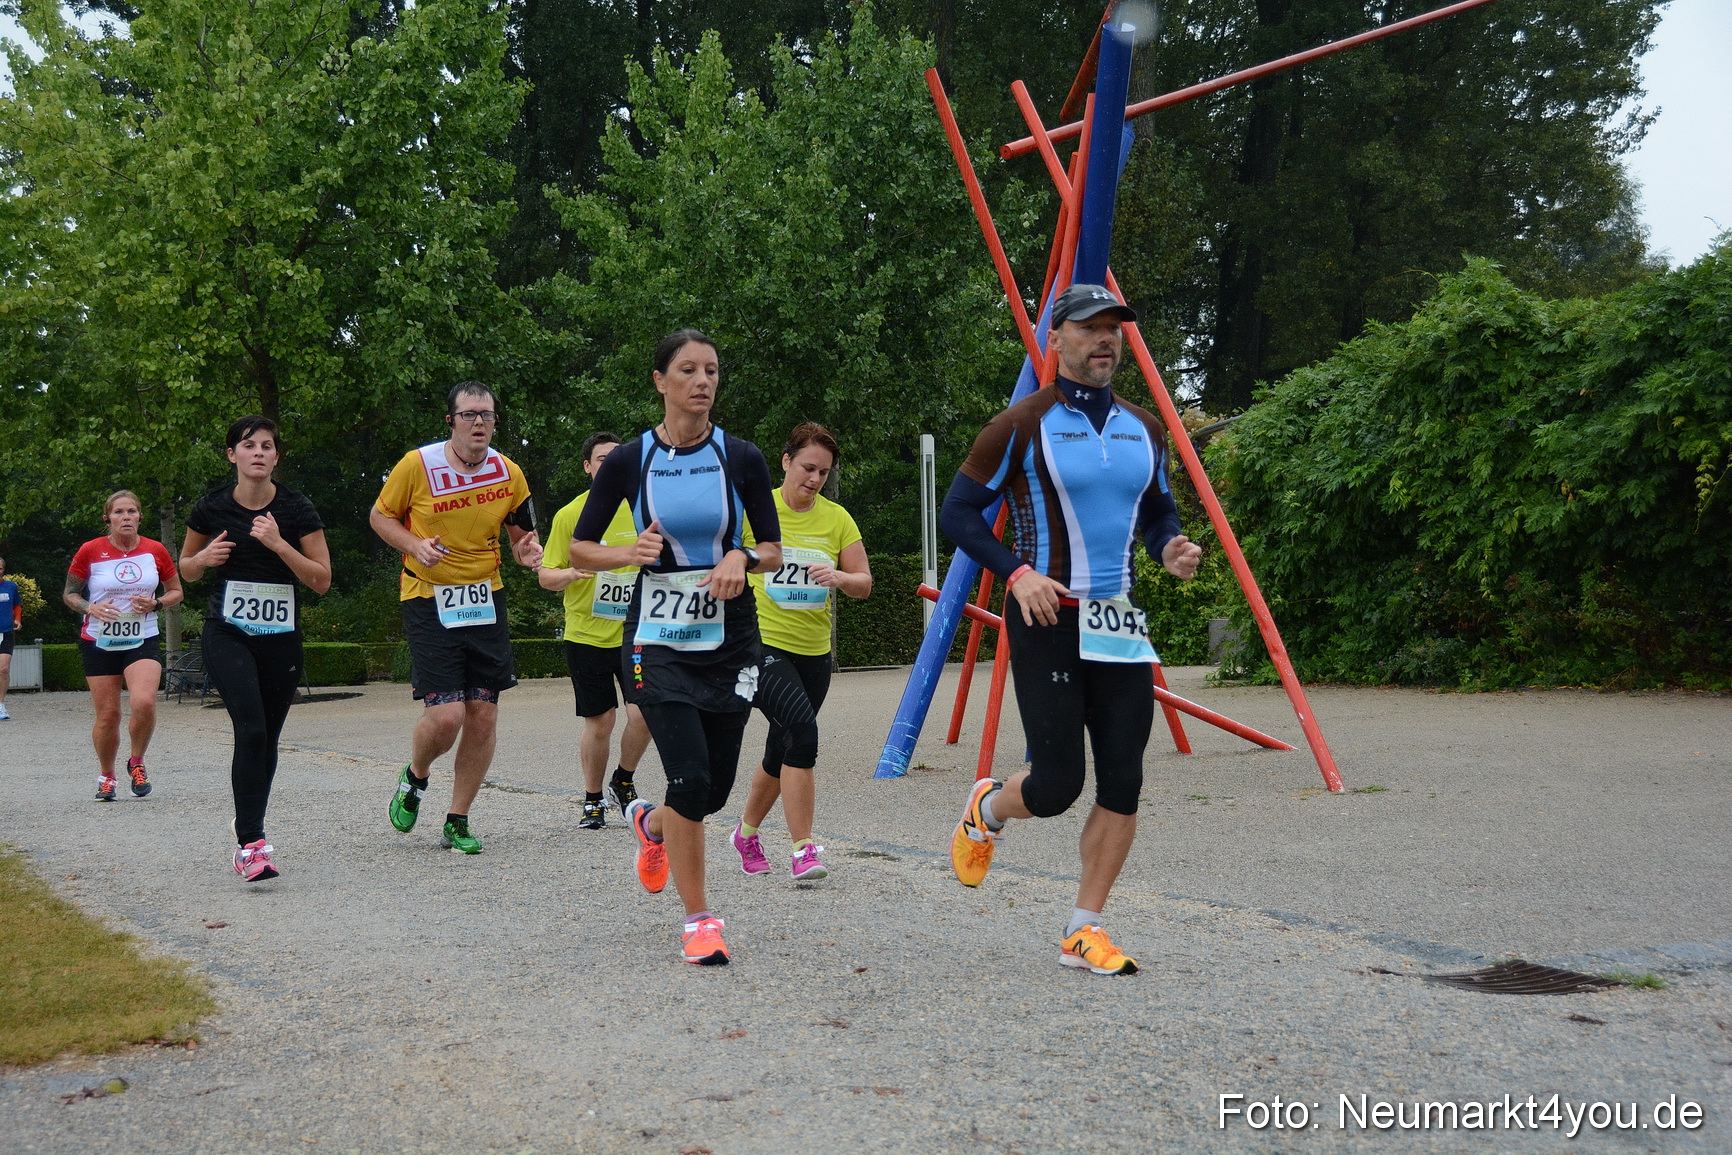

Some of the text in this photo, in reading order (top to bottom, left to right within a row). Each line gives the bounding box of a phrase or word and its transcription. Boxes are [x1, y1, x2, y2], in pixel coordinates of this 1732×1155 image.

[433, 487, 514, 513] MAX BÖGL
[772, 563, 819, 585] 221
[442, 583, 488, 608] 2769
[649, 589, 718, 619] 2748
[787, 591, 808, 601] Julia
[232, 597, 288, 622] 2305
[457, 610, 482, 619] Florian
[613, 606, 628, 614] Tom
[103, 621, 141, 636] 2030
[659, 627, 702, 640] Barbara
[632, 645, 645, 688] sport
